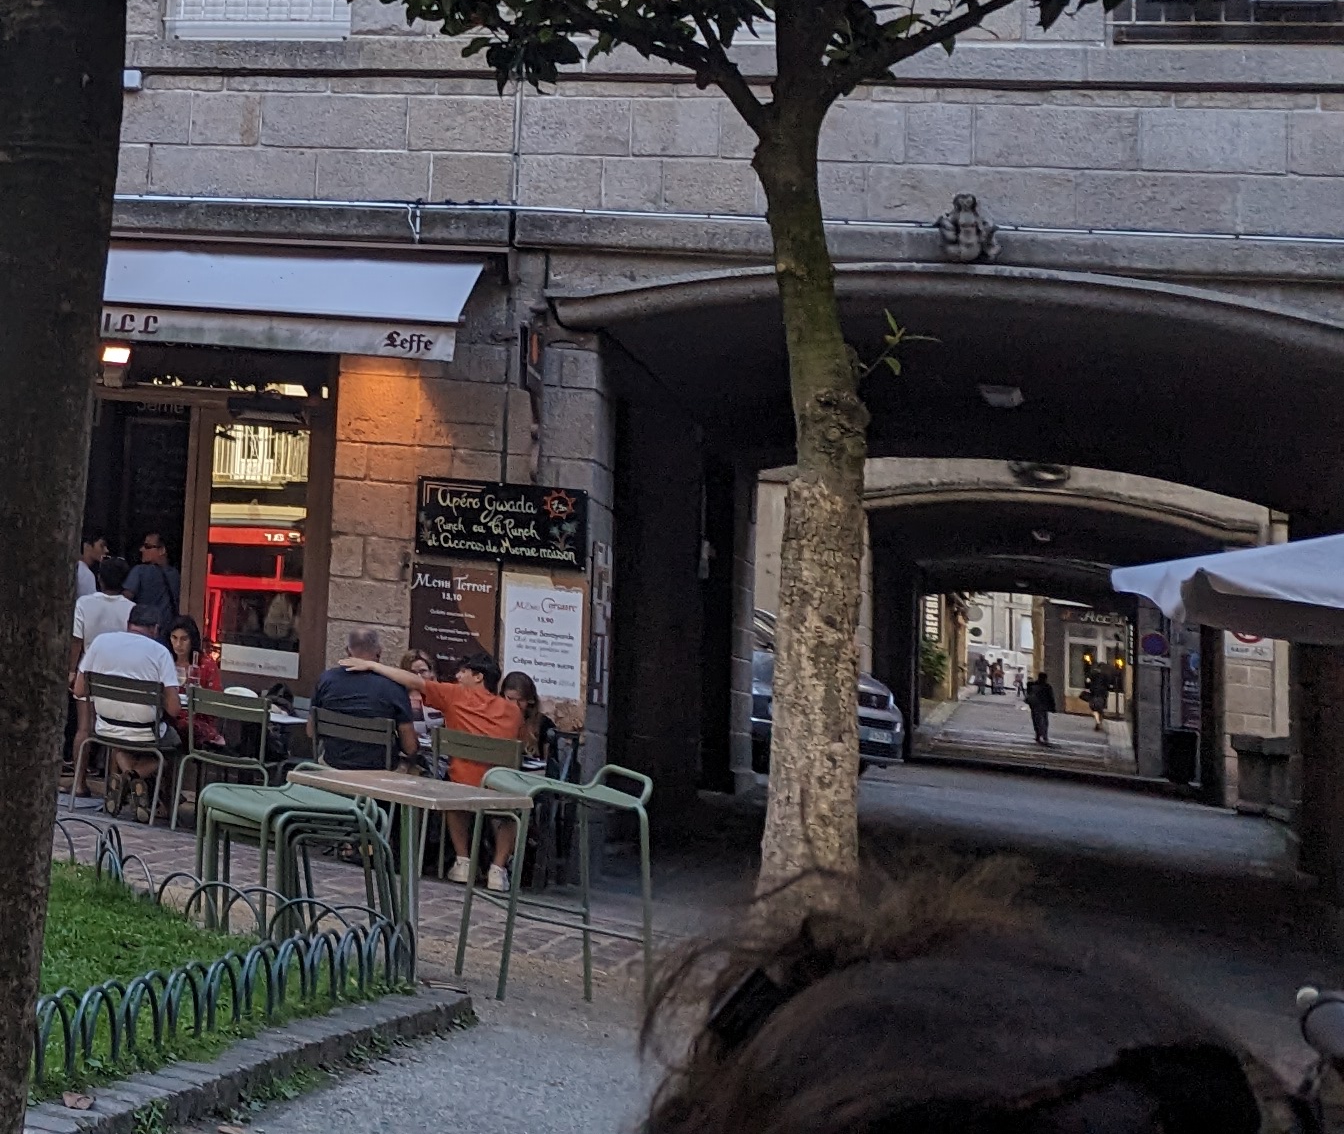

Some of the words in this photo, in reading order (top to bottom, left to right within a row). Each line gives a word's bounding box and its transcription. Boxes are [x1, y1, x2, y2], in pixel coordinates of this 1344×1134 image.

[103, 313, 158, 334] ILL
[383, 330, 435, 354] Leffe
[480, 494, 537, 523] Gwada
[434, 516, 466, 533] Punch
[506, 520, 541, 540] Punch
[411, 572, 451, 590] Menu
[453, 574, 493, 594] Terroir
